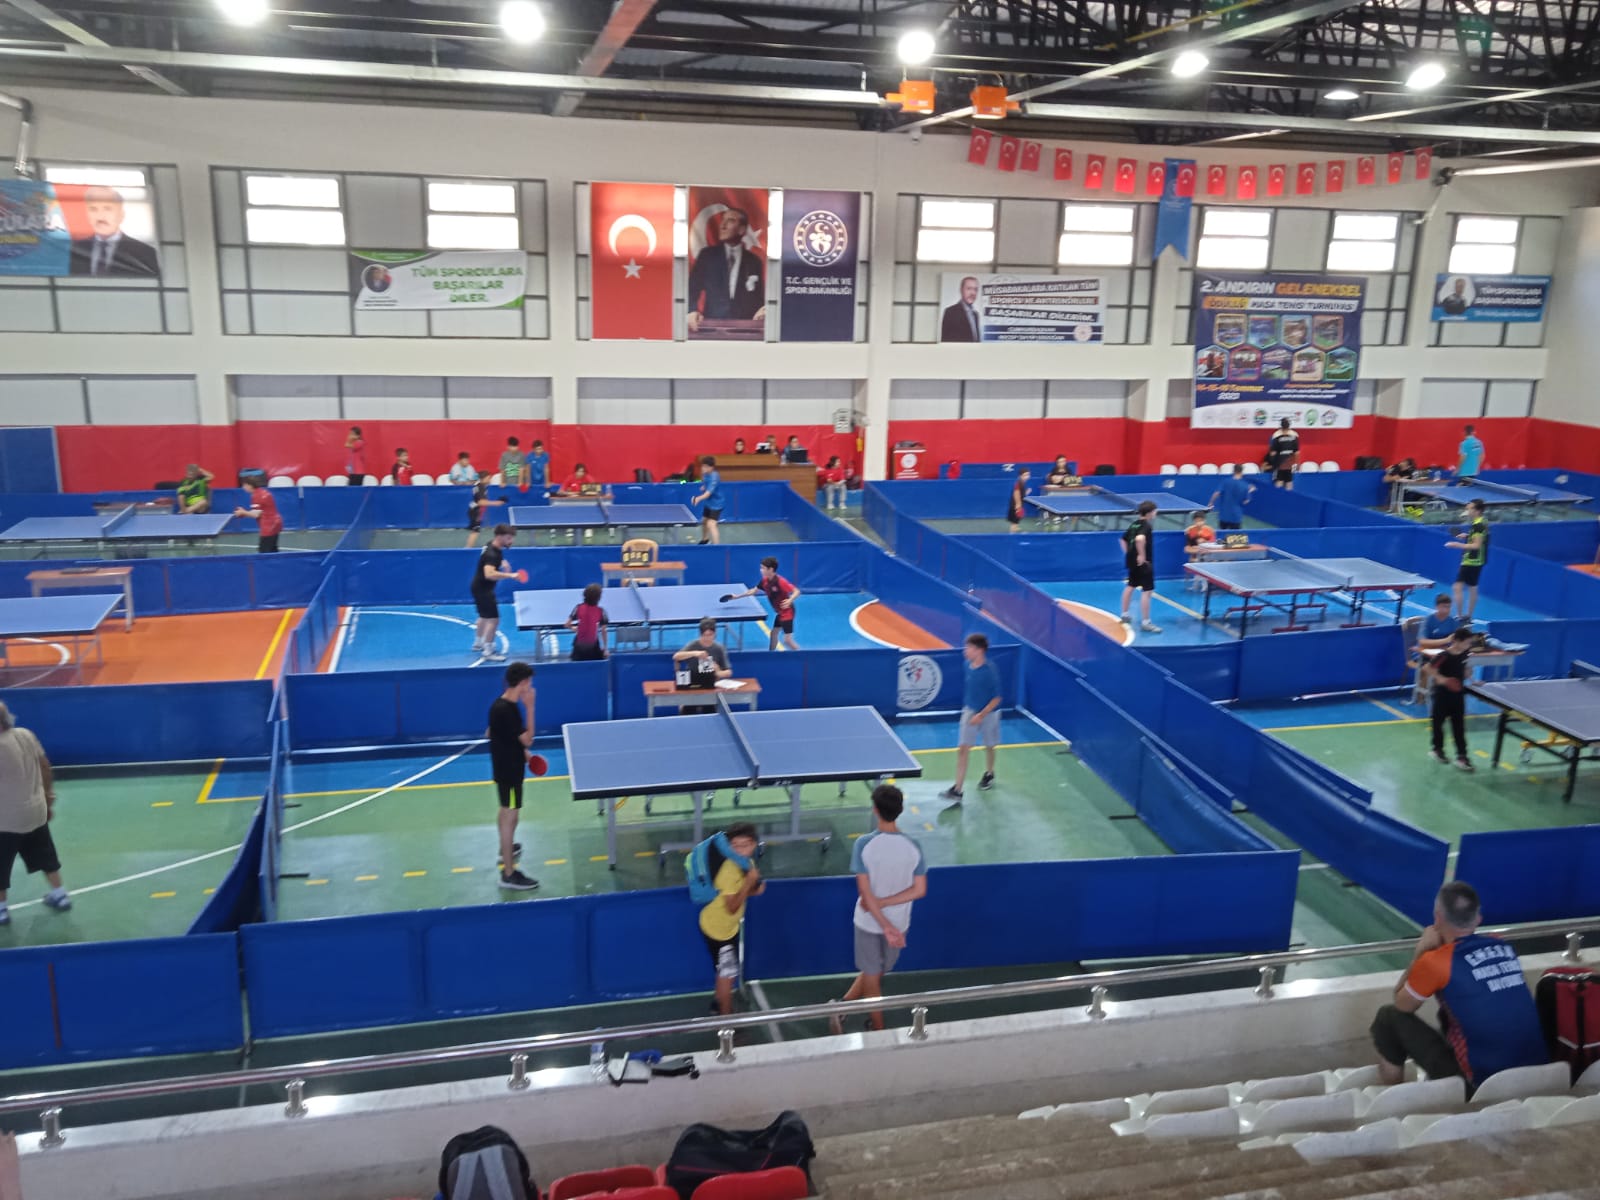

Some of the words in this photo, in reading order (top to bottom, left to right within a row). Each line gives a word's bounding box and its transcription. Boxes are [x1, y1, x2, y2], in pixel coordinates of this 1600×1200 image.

[411, 265, 439, 277] TÜM
[440, 267, 523, 278] SPORCULARA
[432, 280, 504, 292] BAŞARILAR
[785, 286, 807, 295] SPOR
[1214, 280, 1276, 294] ANDIRIN
[1275, 282, 1362, 296] GELENEKSEL
